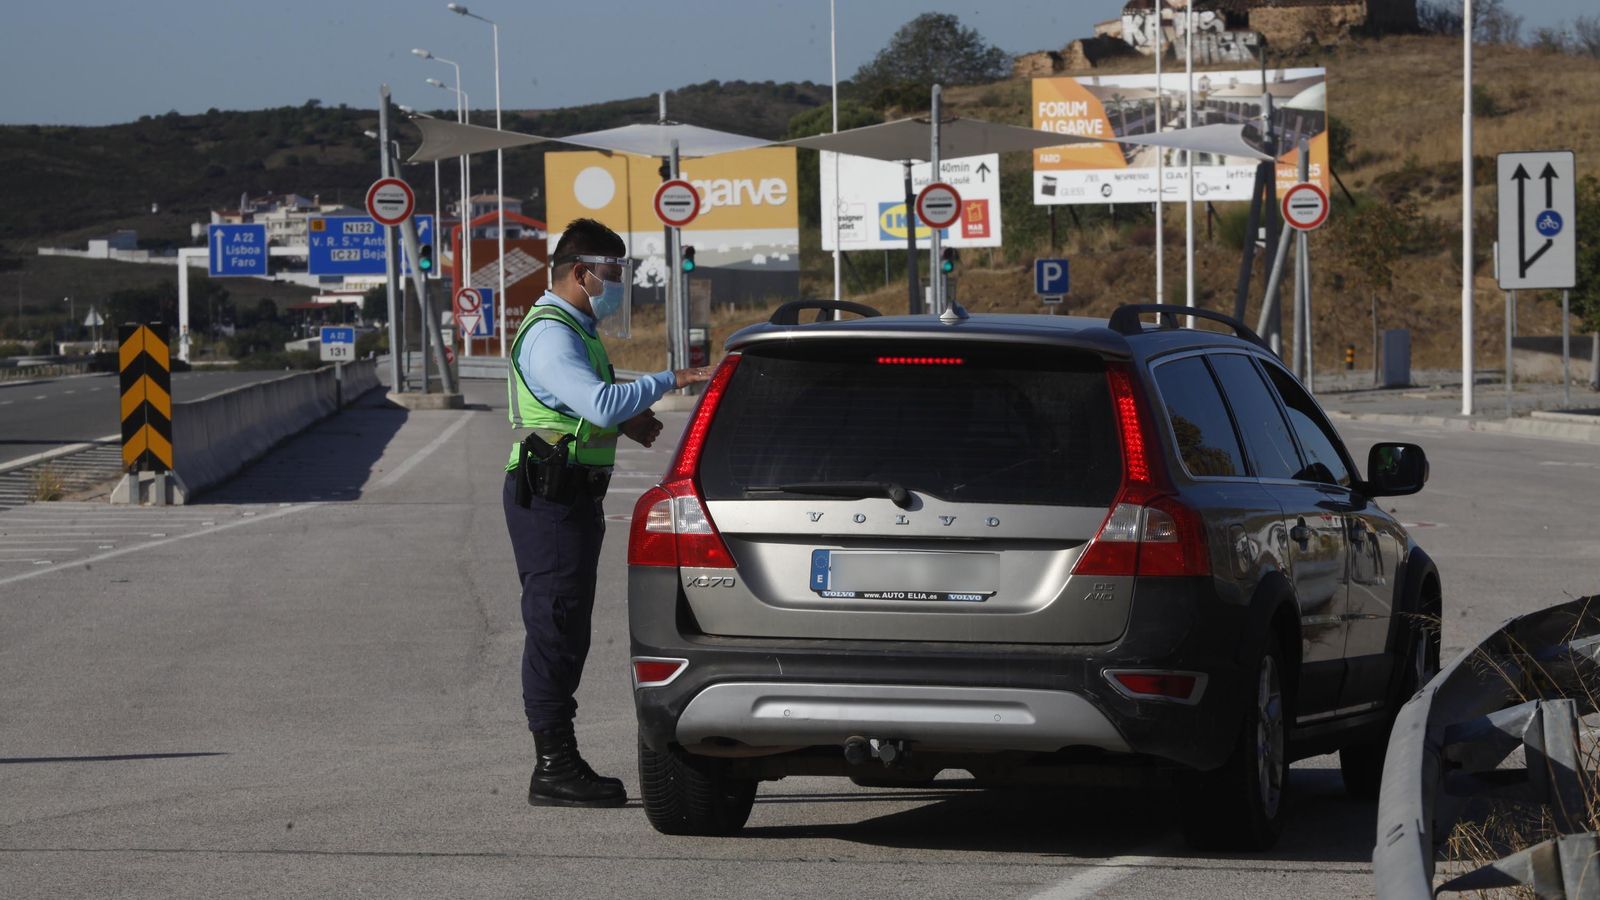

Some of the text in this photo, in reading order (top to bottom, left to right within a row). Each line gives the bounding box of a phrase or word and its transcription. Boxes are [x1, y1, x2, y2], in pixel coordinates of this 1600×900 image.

[1038, 101, 1088, 118] FORUM
[1040, 118, 1104, 136] ALGARVE
[233, 232, 255, 243] A 22
[226, 245, 261, 255] Lisboa
[362, 250, 387, 262] Beja
[231, 257, 257, 267] Faro
[1043, 262, 1062, 291] P
[329, 347, 346, 357] 131
[807, 511, 1001, 528] VOLVO
[686, 574, 737, 588] XC70
[816, 574, 824, 584] E
[822, 590, 857, 598] VOLVO
[907, 592, 927, 600] ELIA
[948, 593, 984, 601] VOLVO
